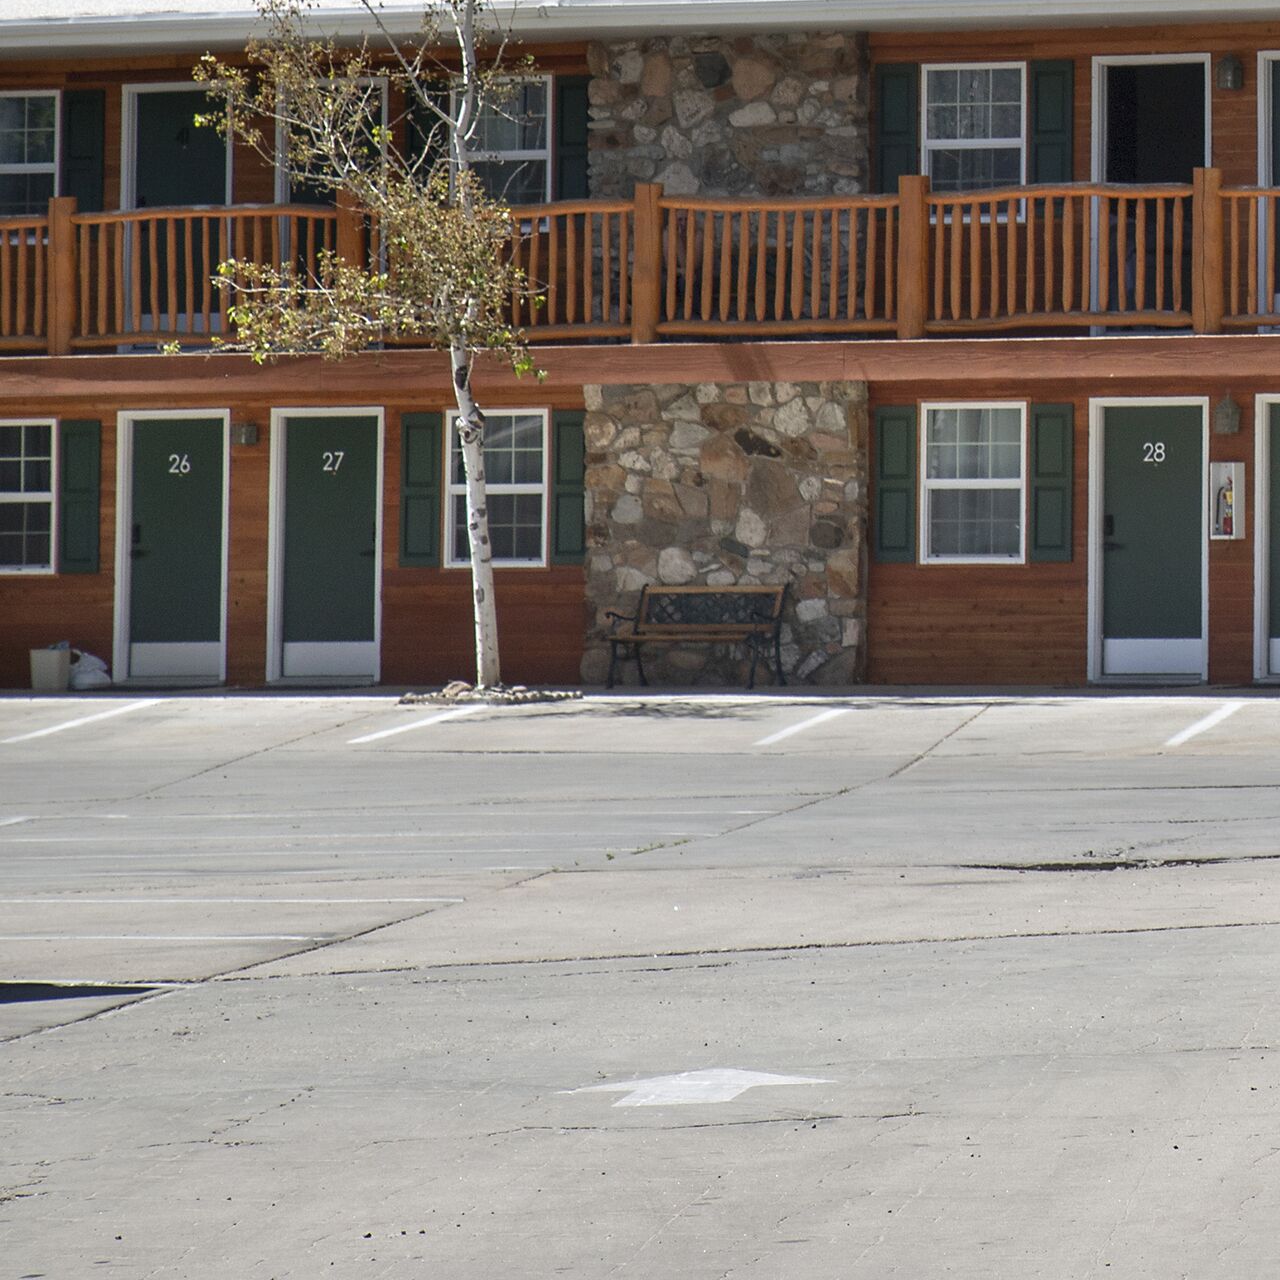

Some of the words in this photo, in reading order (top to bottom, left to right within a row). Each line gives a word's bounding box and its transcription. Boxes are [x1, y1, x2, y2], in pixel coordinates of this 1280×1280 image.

[322, 451, 345, 471] 27
[1143, 442, 1166, 462] 28
[168, 454, 191, 473] 26
